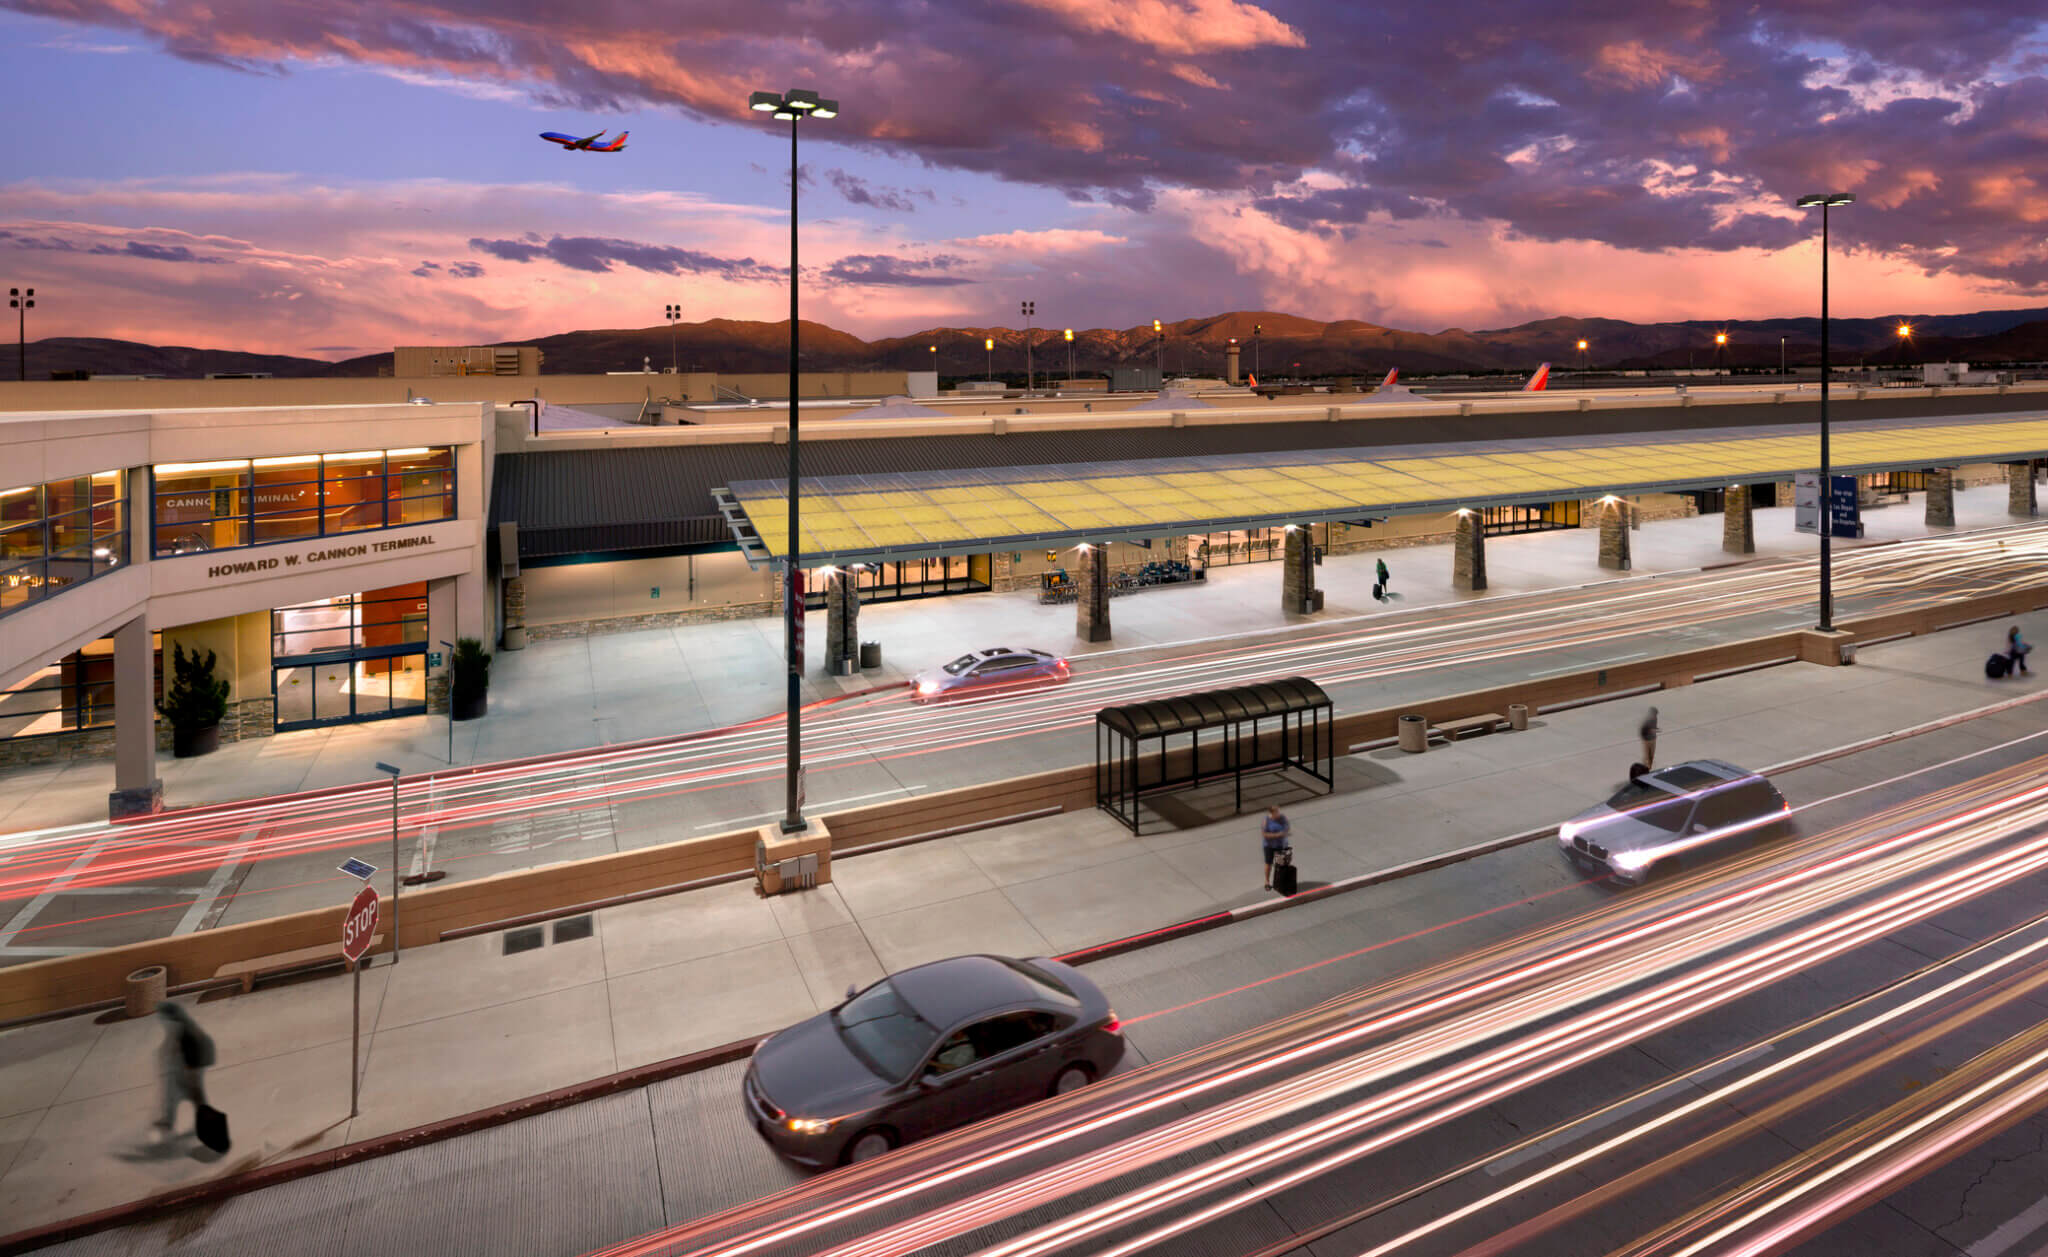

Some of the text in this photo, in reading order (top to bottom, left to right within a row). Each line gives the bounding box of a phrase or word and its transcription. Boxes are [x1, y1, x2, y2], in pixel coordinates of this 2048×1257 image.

[208, 535, 436, 578] HOWARD W. CANNON TERMINAL
[346, 900, 377, 946] STOP
